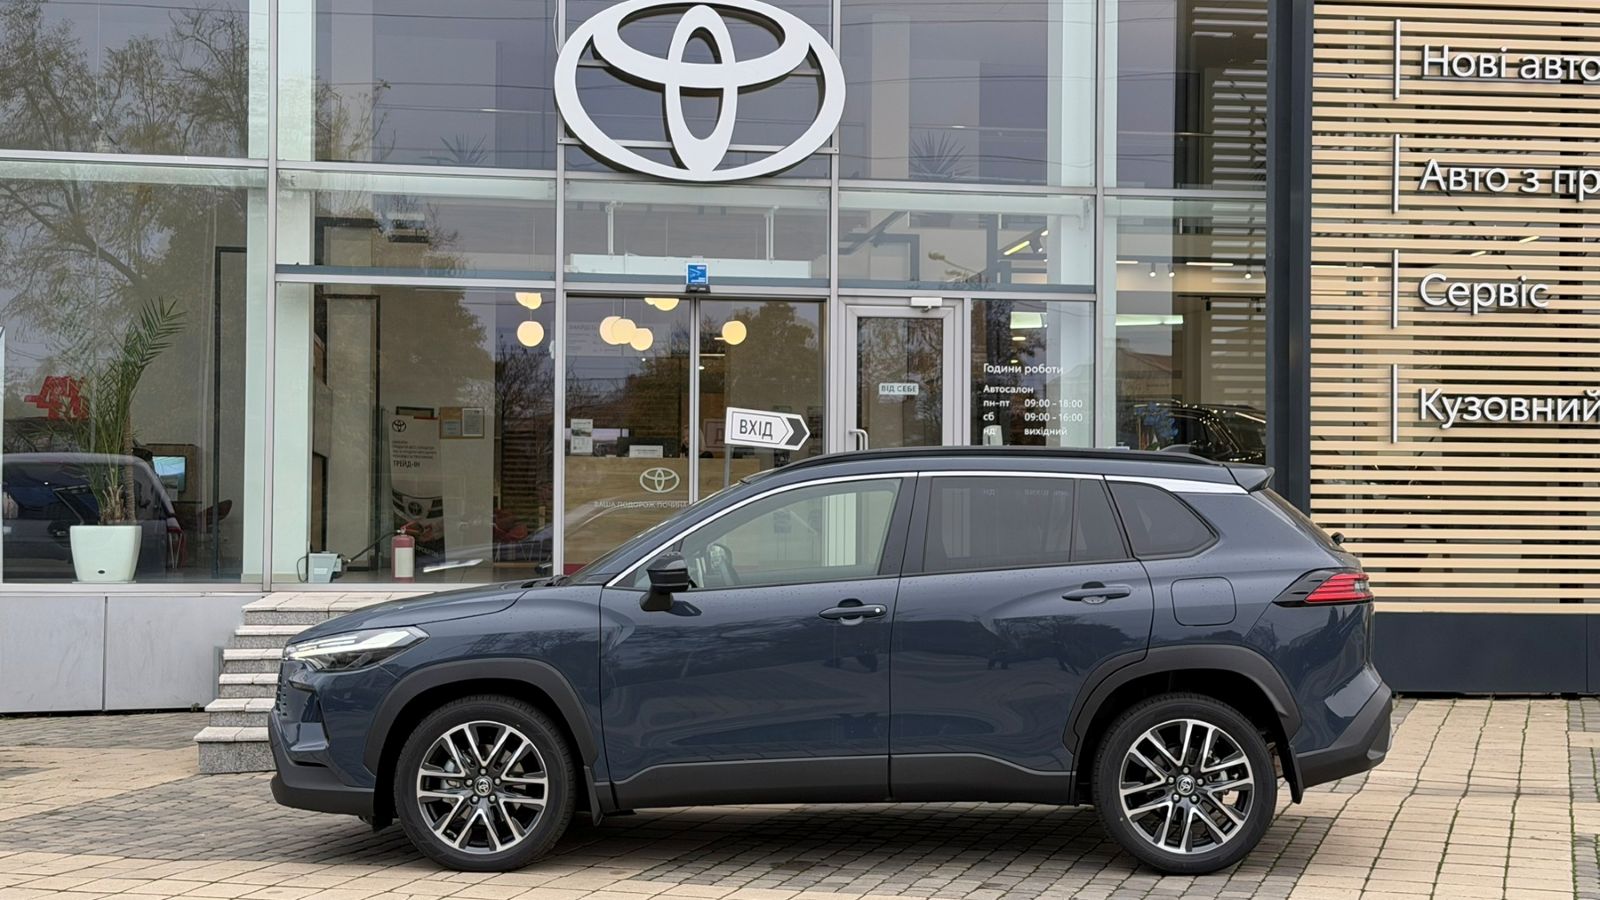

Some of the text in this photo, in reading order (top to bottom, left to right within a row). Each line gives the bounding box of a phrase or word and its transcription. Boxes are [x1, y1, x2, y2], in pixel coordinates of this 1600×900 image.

[1422, 44, 1600, 81] Нові авто
[1418, 158, 1600, 202] Авто з пр
[1420, 272, 1550, 315] Сервіс
[983, 363, 1064, 375] Години роботи
[983, 384, 1034, 393] Автосалон
[1024, 399, 1050, 408] 09:00
[1059, 399, 1083, 408] 18:00
[1420, 387, 1600, 429] Кузовний
[983, 412, 995, 421] сб
[1024, 412, 1050, 421] 09:00
[1059, 412, 1083, 421] 16:00
[739, 419, 774, 441] ВХІД
[1024, 427, 1068, 436] вихідний
